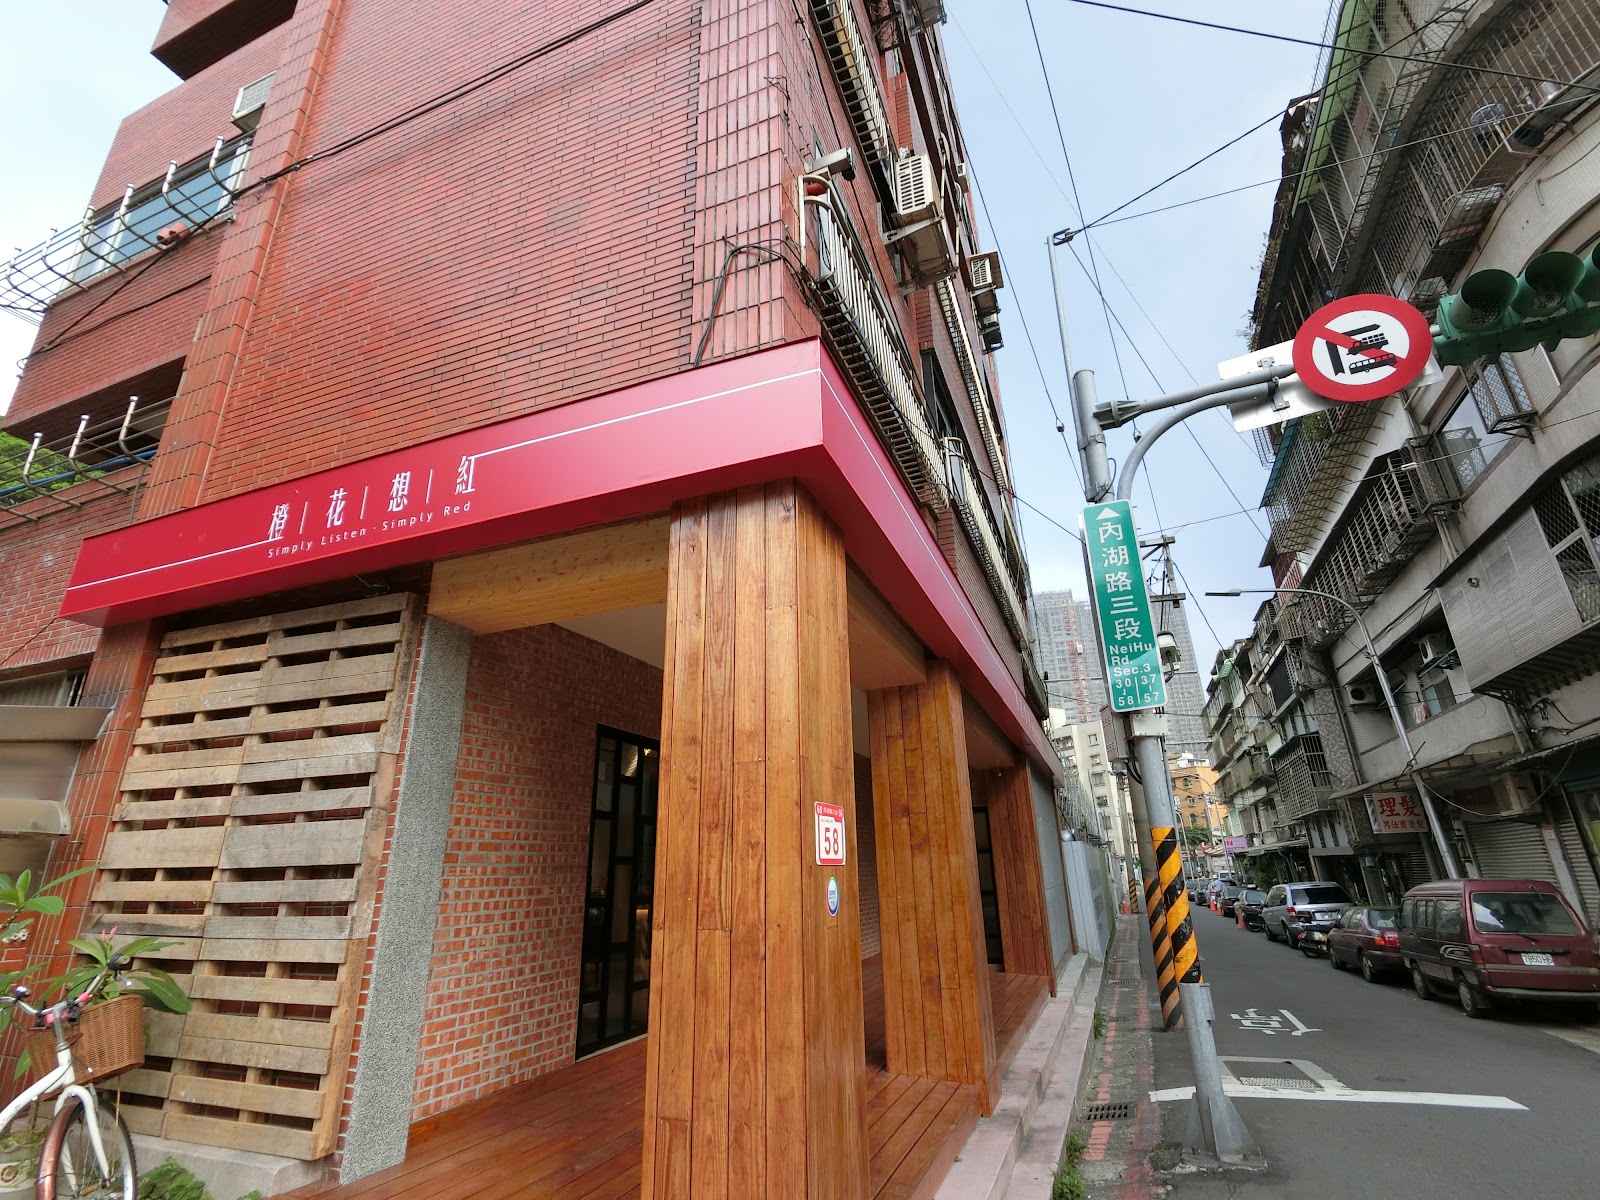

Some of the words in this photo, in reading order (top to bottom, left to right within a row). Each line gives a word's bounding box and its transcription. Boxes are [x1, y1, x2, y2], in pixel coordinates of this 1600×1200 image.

[267, 540, 313, 558] Simply
[321, 528, 366, 545] Listen
[382, 511, 433, 531] Simply
[444, 501, 471, 516] Red
[1109, 642, 1153, 655] NeiHu
[1111, 655, 1133, 666] Rd.
[1113, 663, 1151, 677] Sec.3
[1115, 677, 1132, 689] 30
[1141, 674, 1157, 685] 37
[1118, 695, 1134, 707] 58
[1144, 691, 1160, 703] 57
[1377, 795, 1422, 817] 理髮
[824, 827, 839, 855] 58
